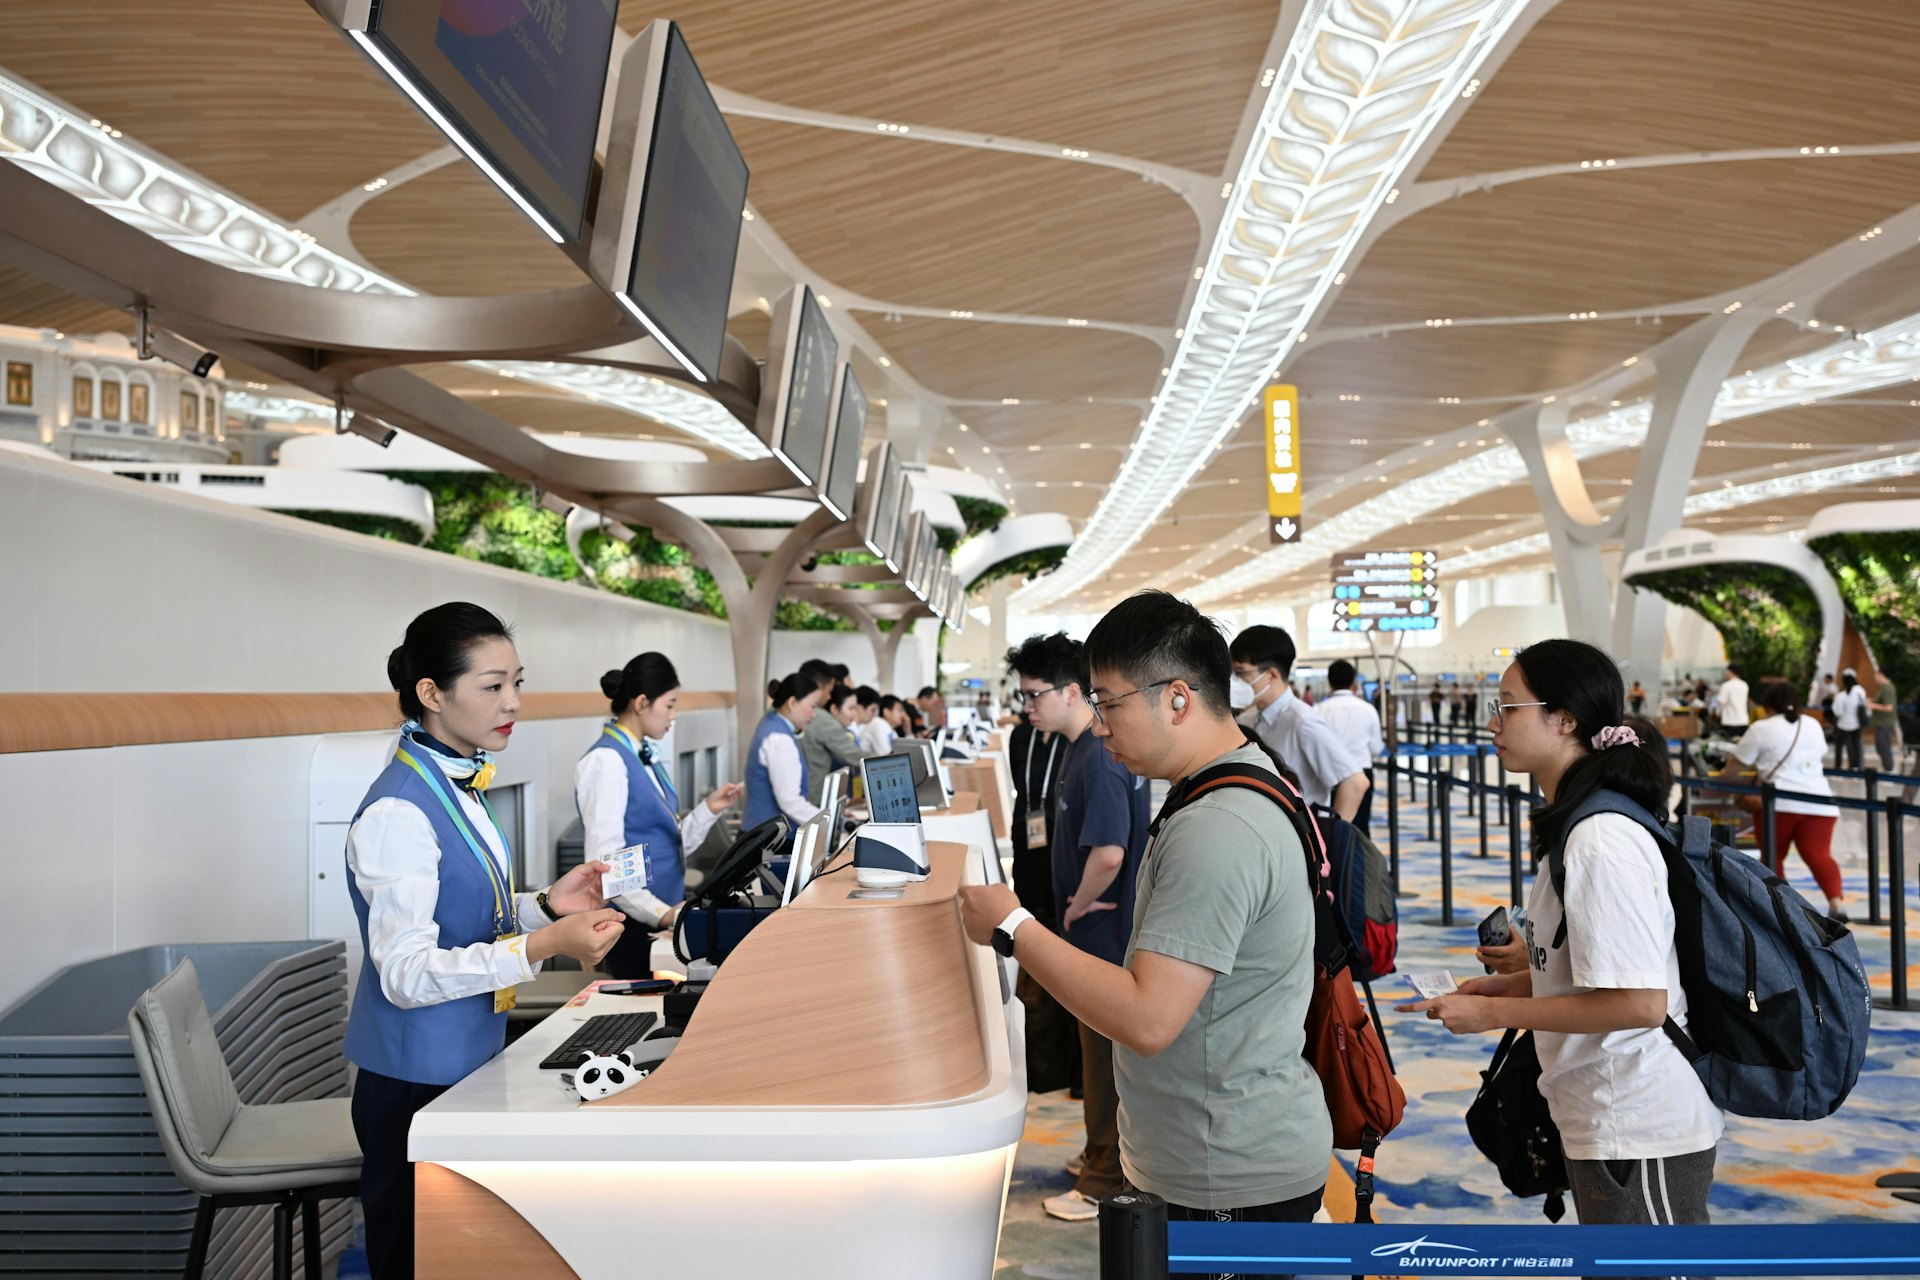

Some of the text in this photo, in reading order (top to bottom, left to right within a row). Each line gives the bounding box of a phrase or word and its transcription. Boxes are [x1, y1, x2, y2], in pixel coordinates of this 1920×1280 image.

[1399, 1257, 1574, 1268] BAIYUNPORT 广州白云机场
